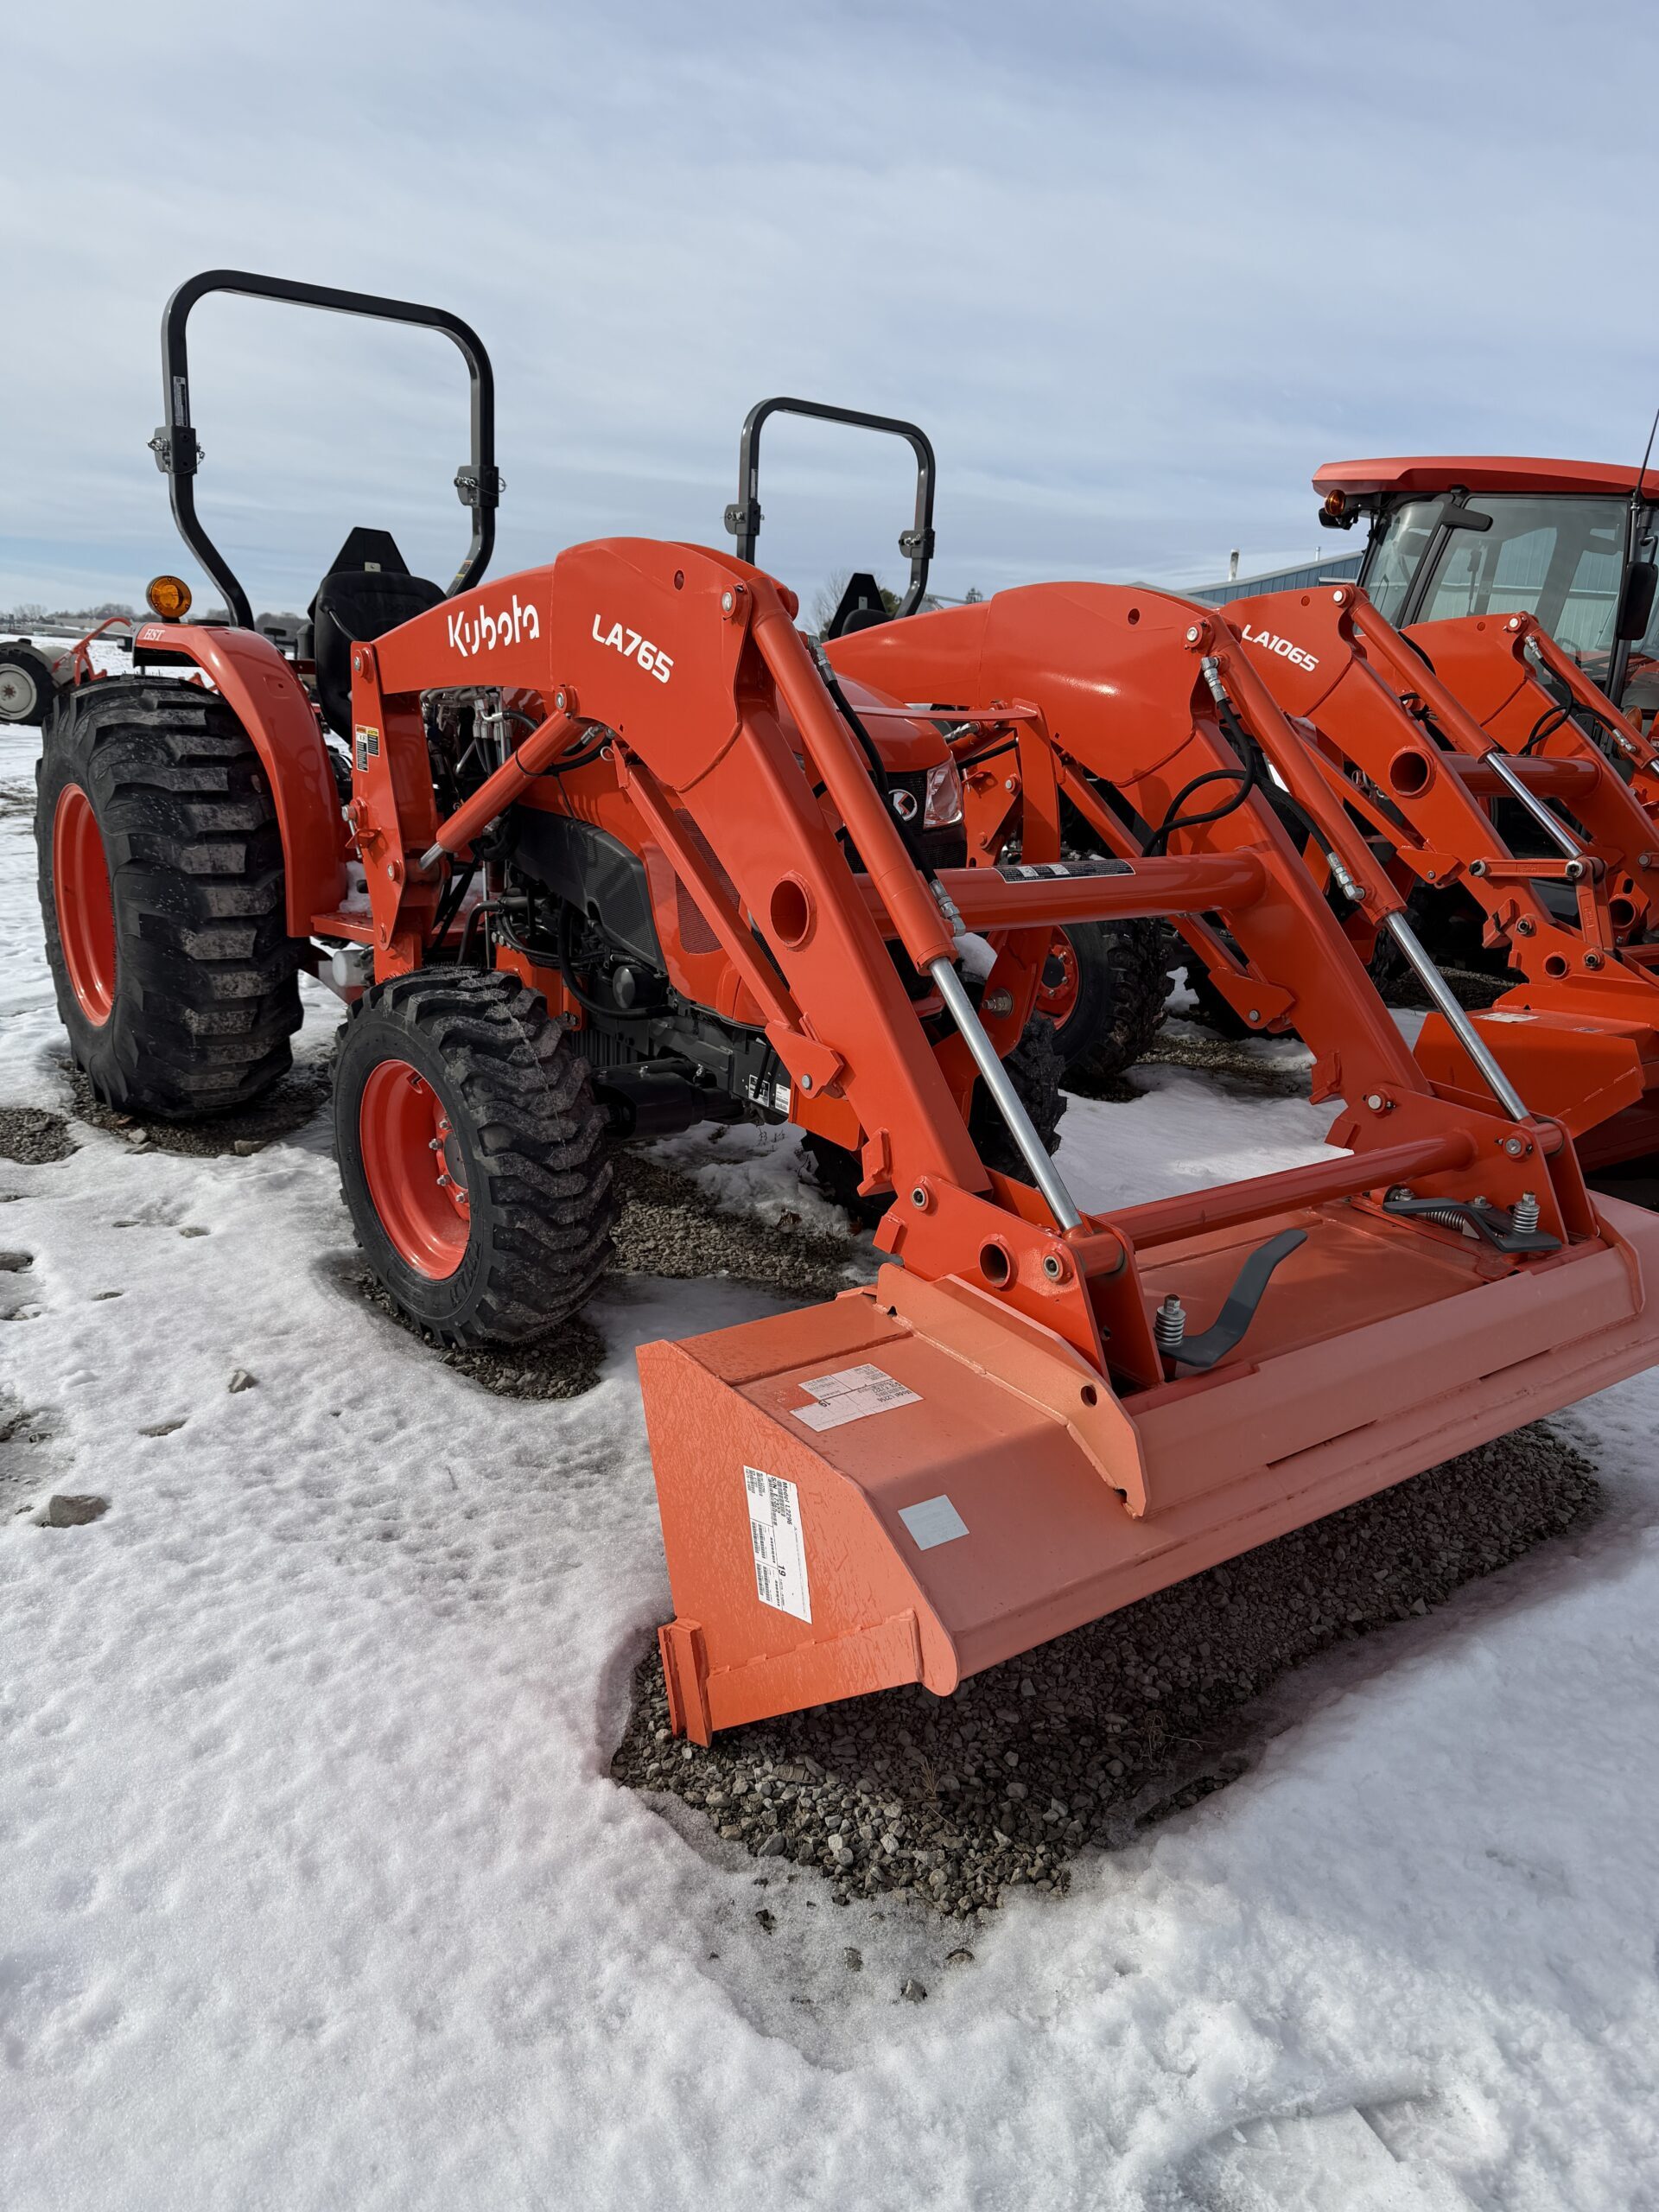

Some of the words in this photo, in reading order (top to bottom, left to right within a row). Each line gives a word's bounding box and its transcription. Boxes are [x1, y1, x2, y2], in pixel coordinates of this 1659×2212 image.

[143, 629, 165, 640] HST
[448, 594, 540, 657] Kubota
[592, 613, 675, 683] LA765
[1242, 625, 1319, 671] LA1065
[777, 1562, 786, 1578] 19
